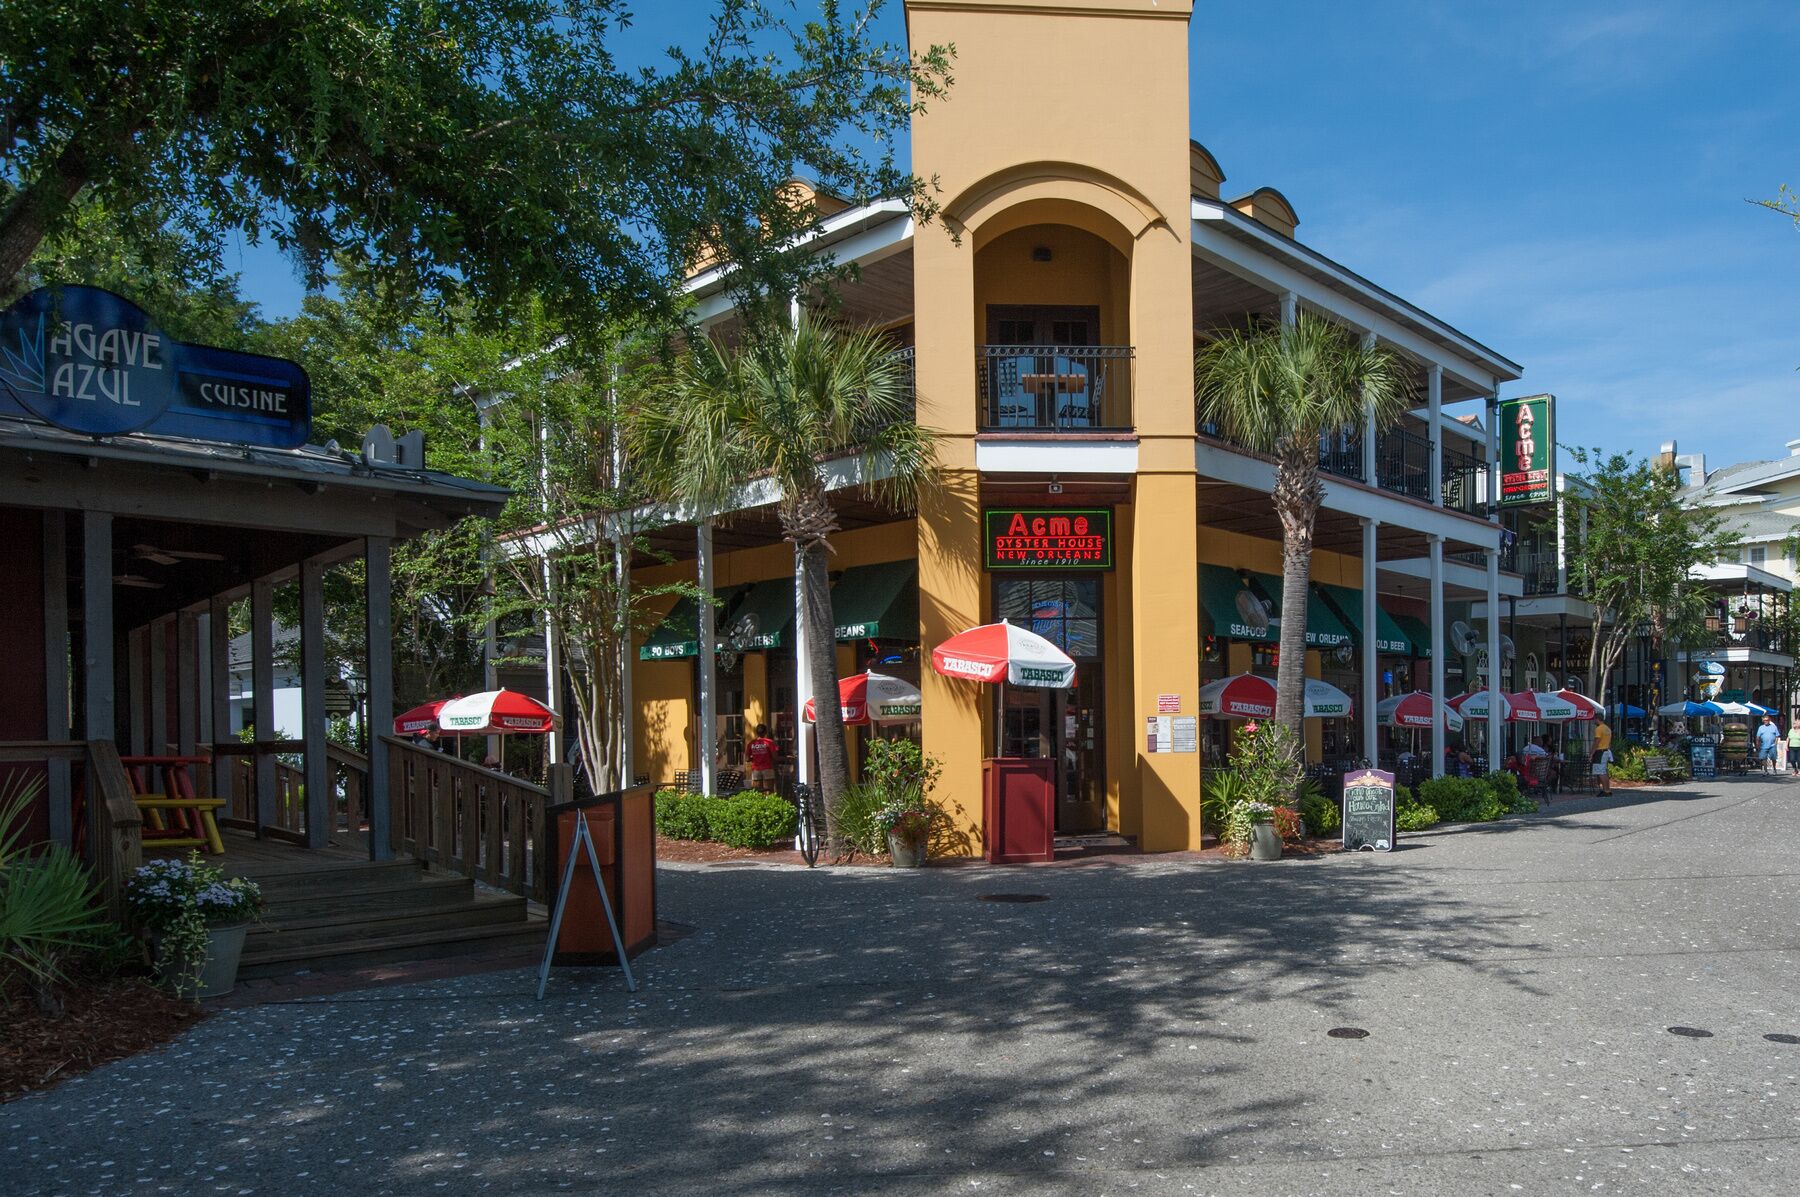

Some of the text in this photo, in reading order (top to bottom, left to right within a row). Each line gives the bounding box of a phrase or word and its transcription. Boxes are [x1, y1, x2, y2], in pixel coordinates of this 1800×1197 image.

[50, 320, 162, 370] AGAVE
[52, 362, 141, 406] AZUL
[200, 383, 288, 413] CUISINE
[1008, 513, 1088, 536] Acme
[996, 538, 1103, 548] OYSTER HOUSE
[996, 550, 1101, 560] NEW ORLEANS
[1020, 558, 1080, 566] Since 1910
[834, 625, 865, 638] BEANS
[1230, 623, 1267, 638] SEAFOOD
[1306, 632, 1317, 643] EW
[664, 644, 684, 656] BOYS
[1376, 640, 1405, 651] OLD BEER
[944, 657, 994, 676] TABASCO
[1021, 667, 1064, 682] TABASCO
[1230, 701, 1273, 716] TABASCO
[450, 716, 482, 726] TABASCO
[502, 716, 543, 727] TABASCO
[1404, 715, 1433, 724] TABASC
